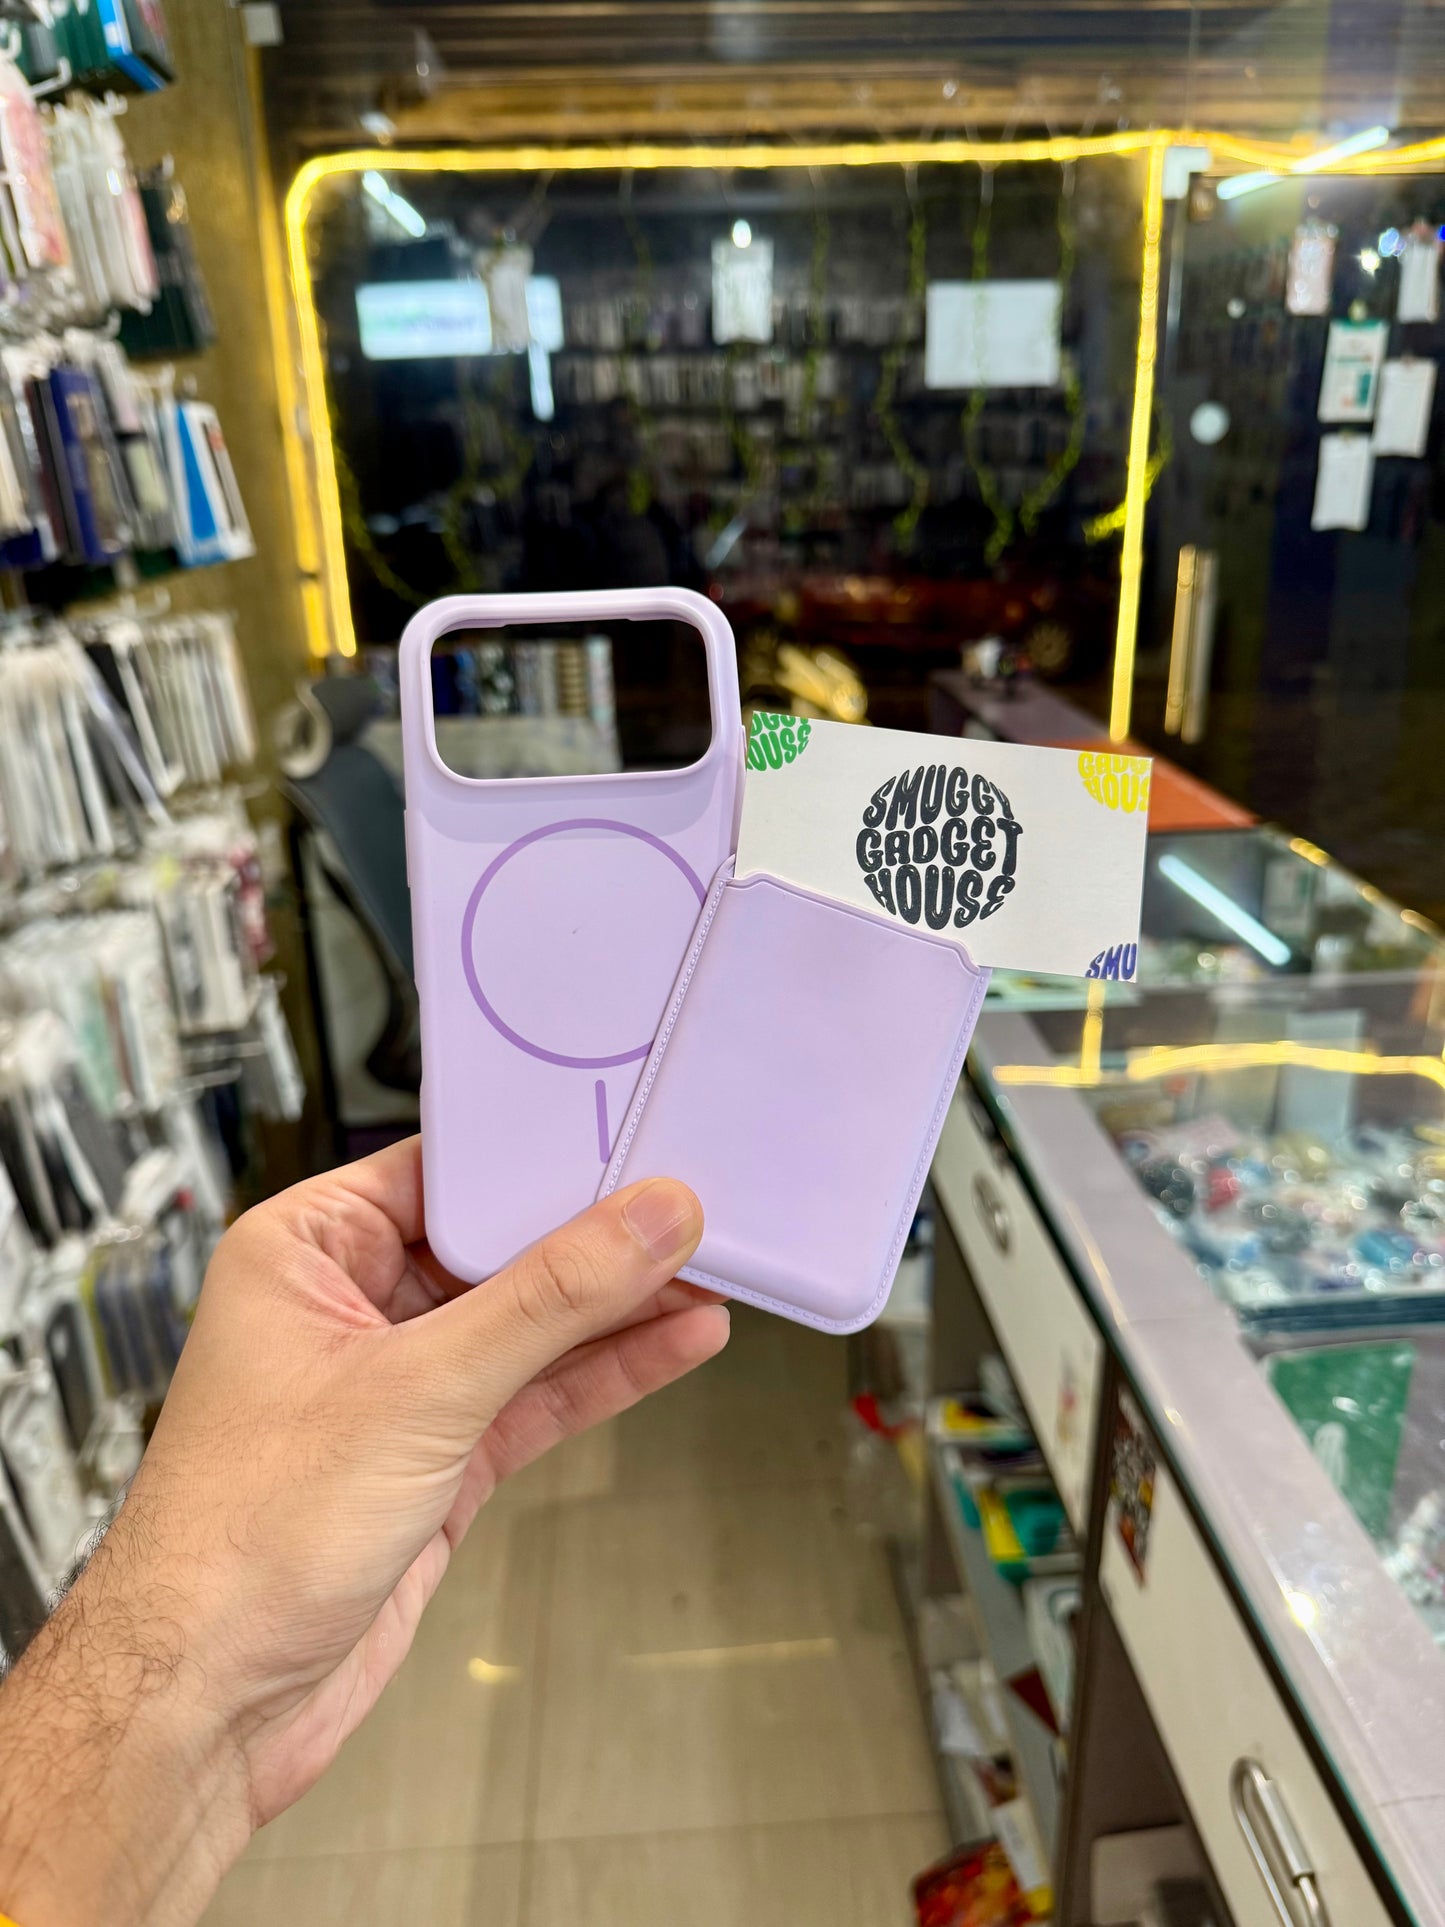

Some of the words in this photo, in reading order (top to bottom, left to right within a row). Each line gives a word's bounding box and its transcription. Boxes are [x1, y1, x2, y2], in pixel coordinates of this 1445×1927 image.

[747, 724, 811, 771] OUSE
[863, 764, 1014, 831] SMUGGY
[856, 816, 1023, 873] GADGET
[864, 864, 1015, 930] HOUSE
